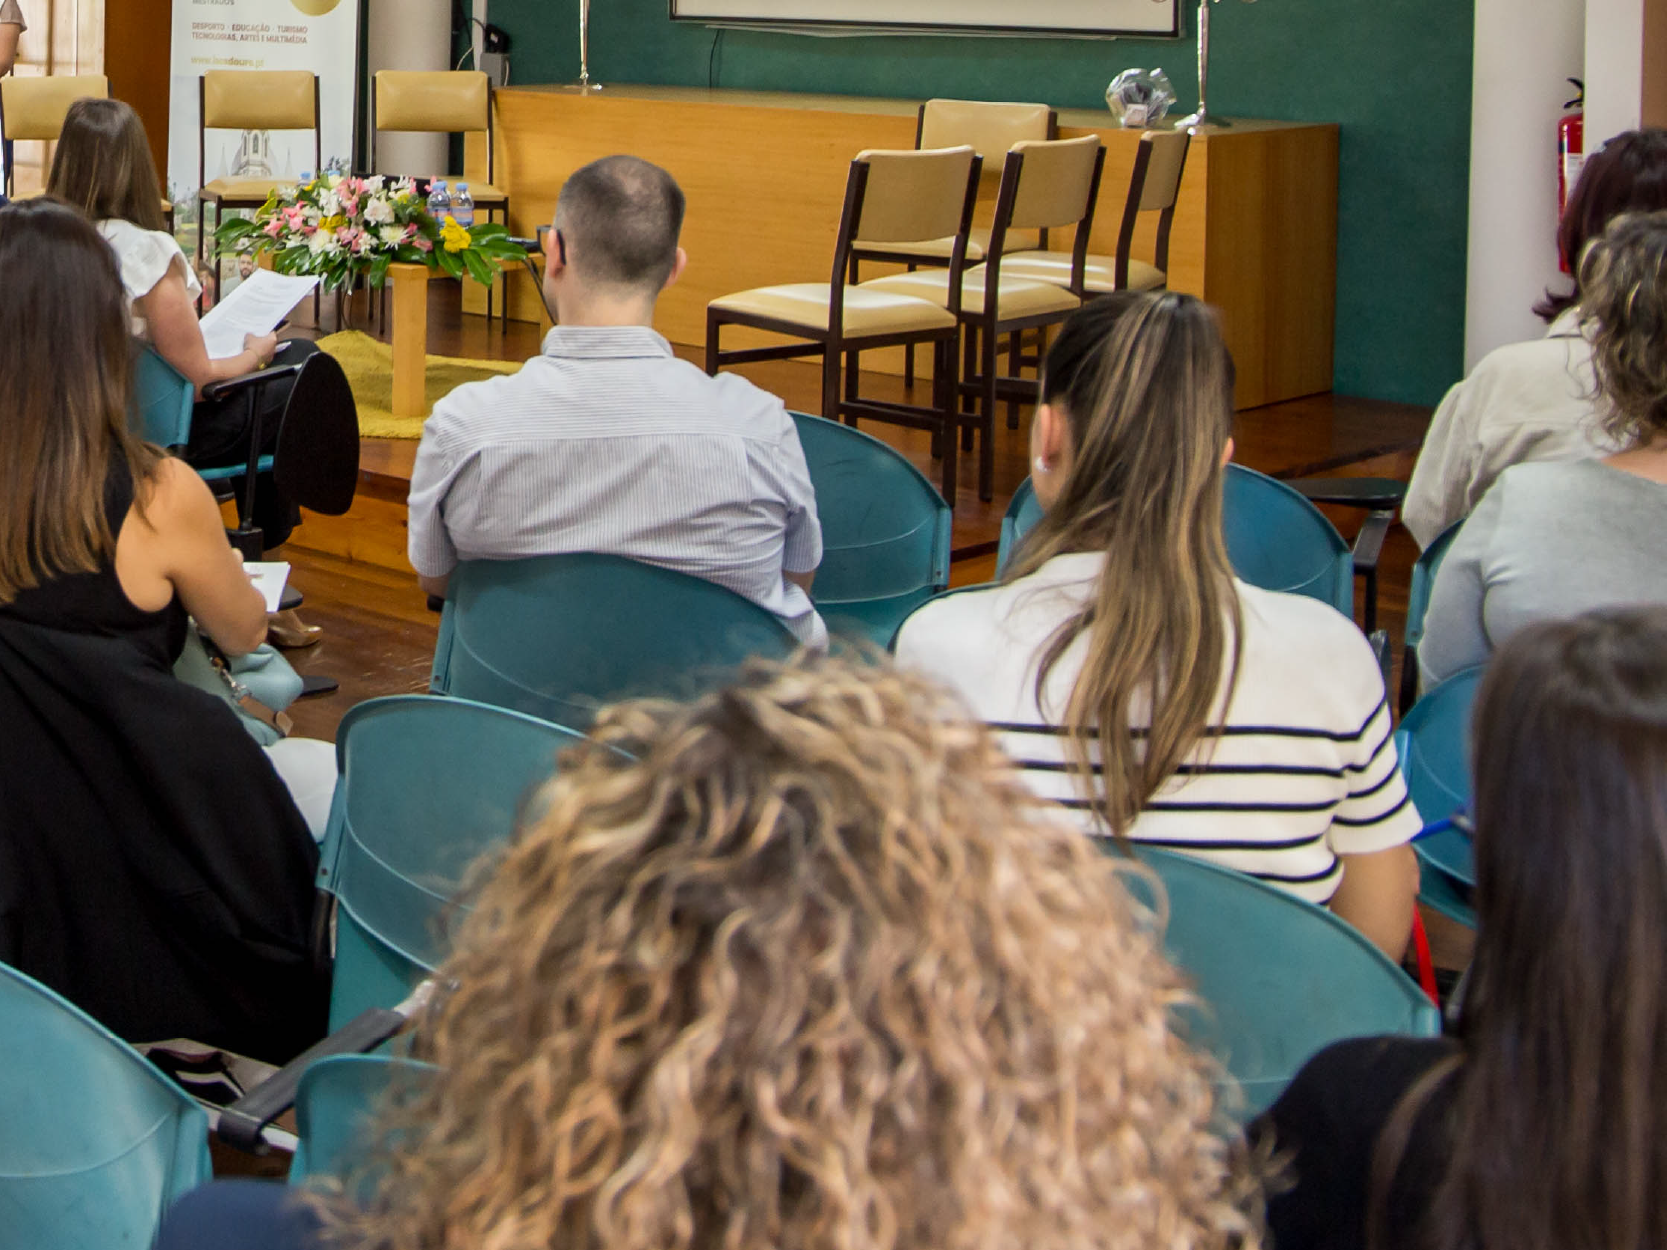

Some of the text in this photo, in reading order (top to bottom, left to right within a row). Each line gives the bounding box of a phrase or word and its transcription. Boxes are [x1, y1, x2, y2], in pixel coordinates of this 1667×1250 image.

[192, 22, 309, 34] DESPORTO EDUCAÇÃO TURISMO
[240, 33, 259, 43] ARTES
[266, 34, 308, 44] MULTIMÉDIA
